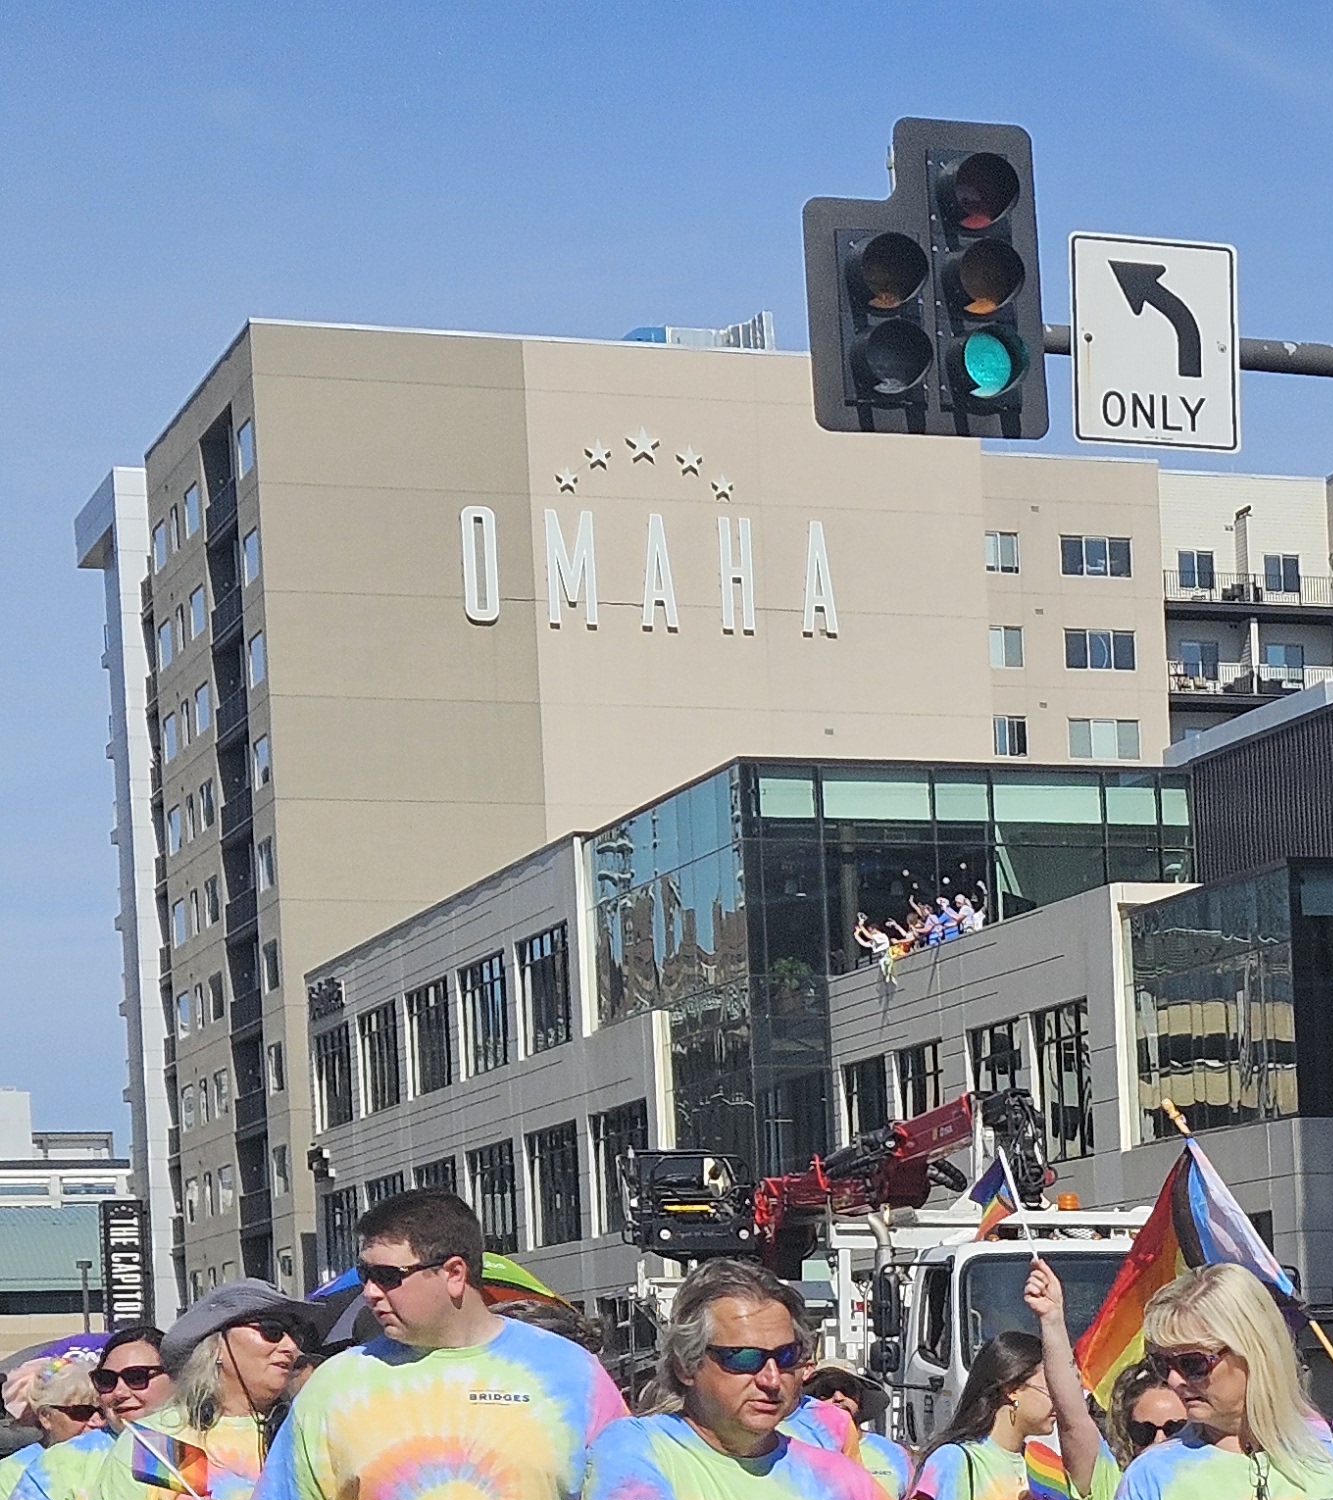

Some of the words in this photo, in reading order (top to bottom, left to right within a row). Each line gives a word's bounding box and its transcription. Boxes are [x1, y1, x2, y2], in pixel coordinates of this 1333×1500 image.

[1102, 390, 1206, 432] ONLY
[461, 505, 838, 639] OMAHA
[110, 1217, 139, 1246] THE
[110, 1252, 142, 1322] CAPITOL
[469, 1393, 531, 1403] BRIDGES
